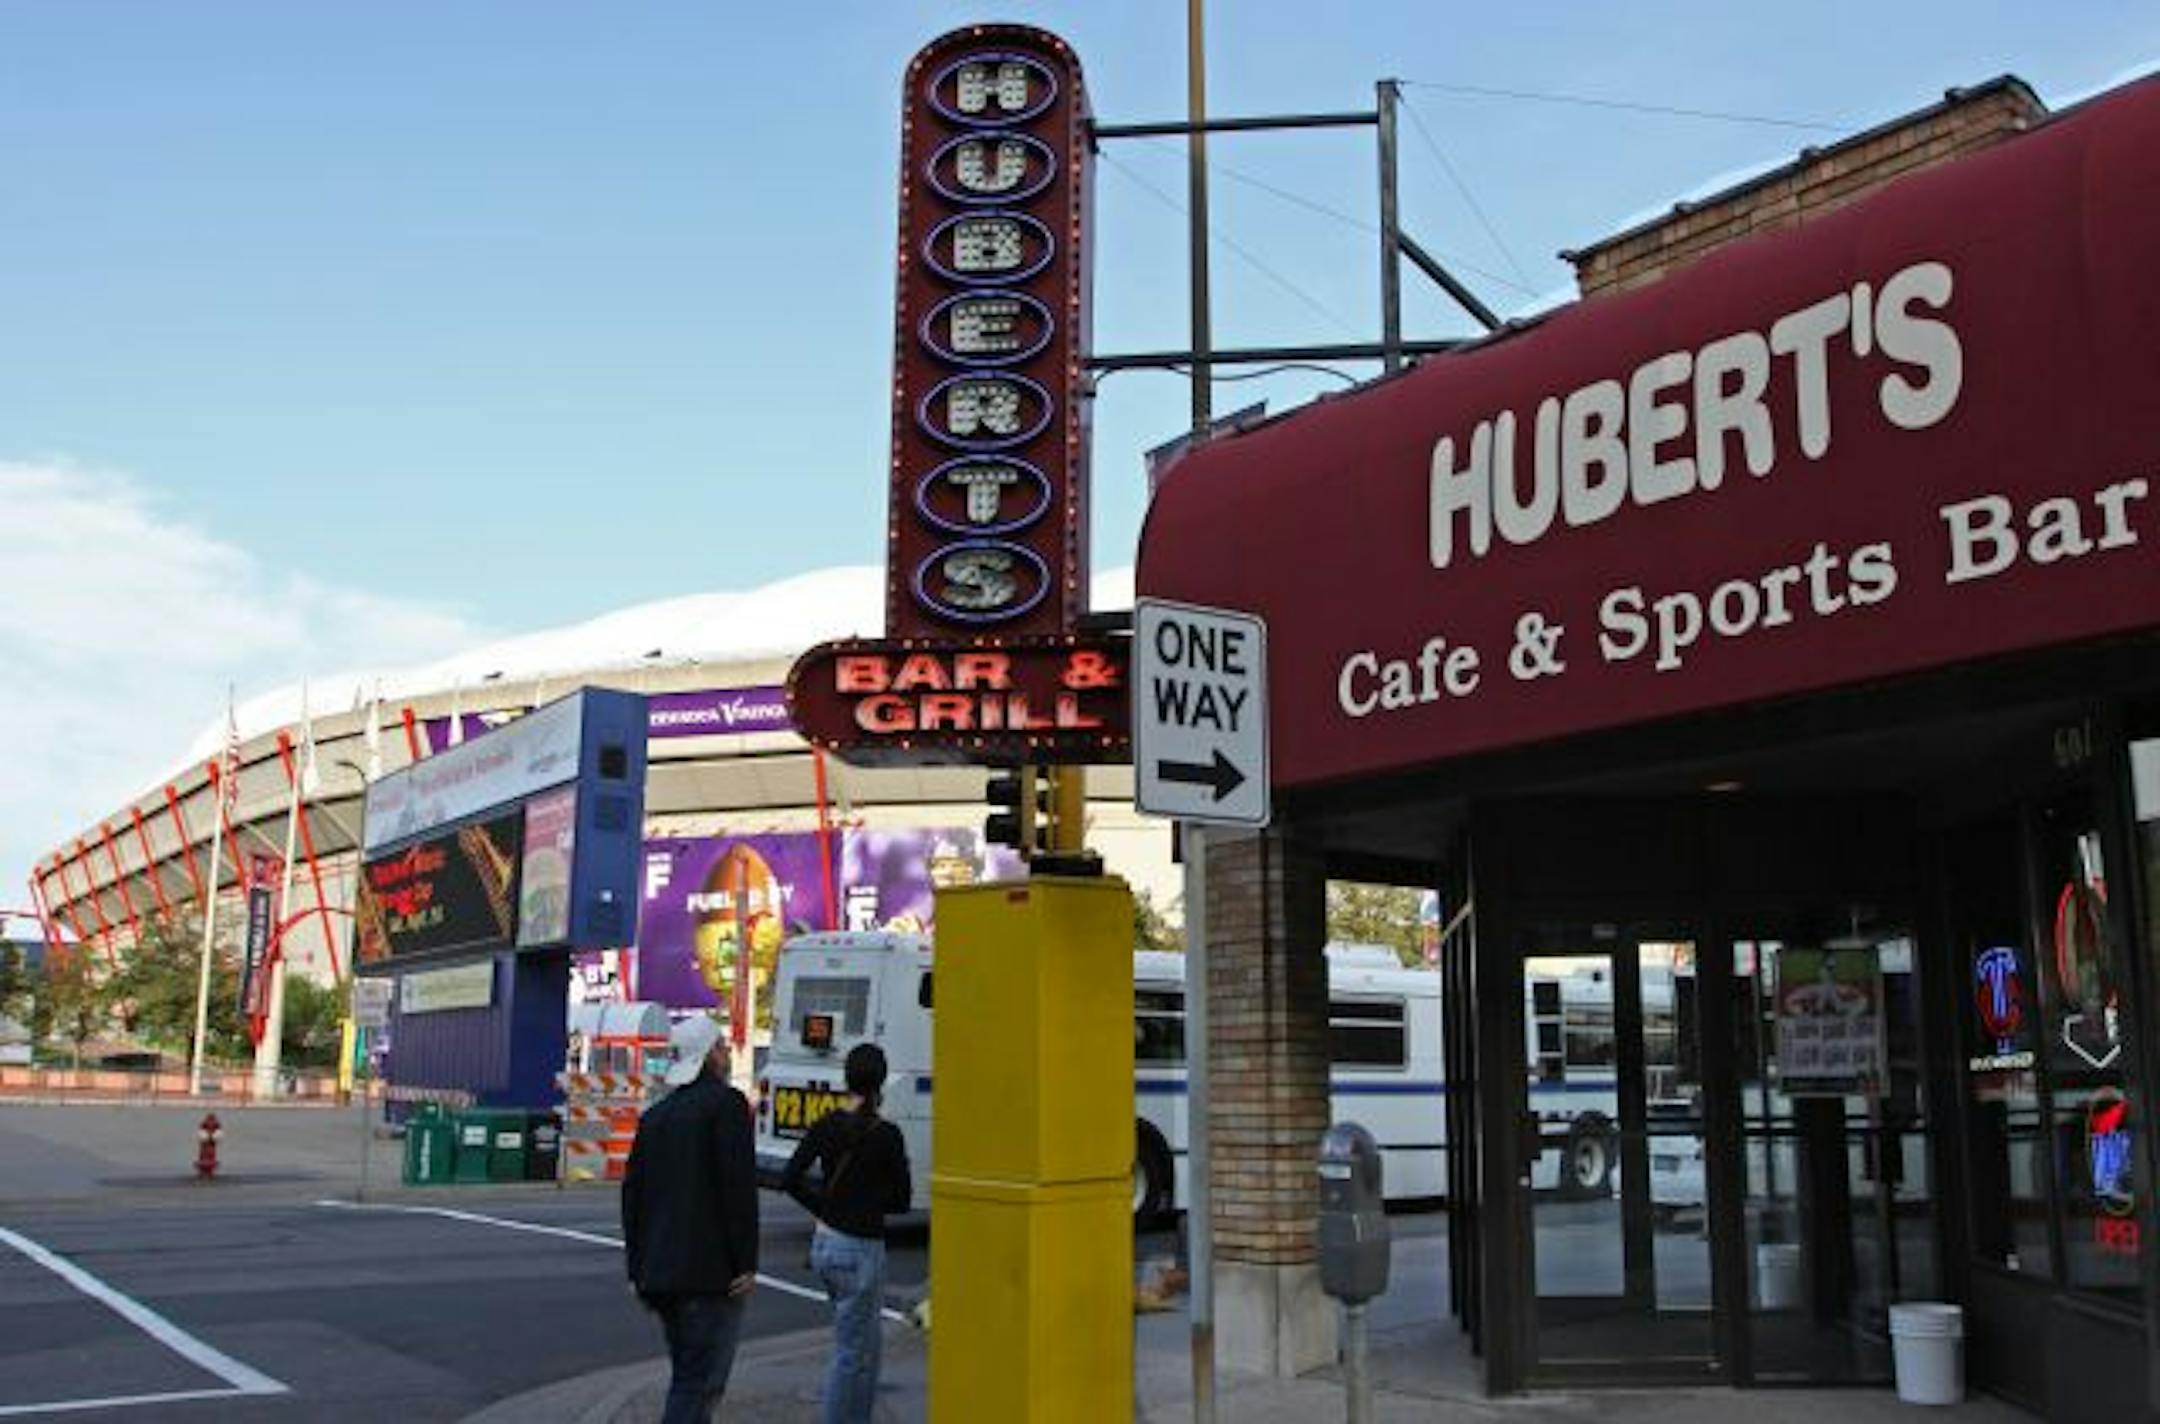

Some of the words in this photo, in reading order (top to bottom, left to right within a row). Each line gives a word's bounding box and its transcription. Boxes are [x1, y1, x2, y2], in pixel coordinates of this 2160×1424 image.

[942, 61, 1029, 609] HUBERTS
[1428, 261, 1963, 570] HUBERT'S
[1337, 636, 1481, 717] Cafe
[1508, 611, 1566, 680] &
[1598, 542, 1899, 671] Sports
[1938, 478, 2149, 583] Bar
[836, 653, 1010, 692] BAR
[1062, 651, 1116, 691] &
[1154, 619, 1248, 677] ONE
[855, 693, 1101, 733] GRILL
[1153, 677, 1249, 733] WAY
[686, 888, 764, 913] FUELD
